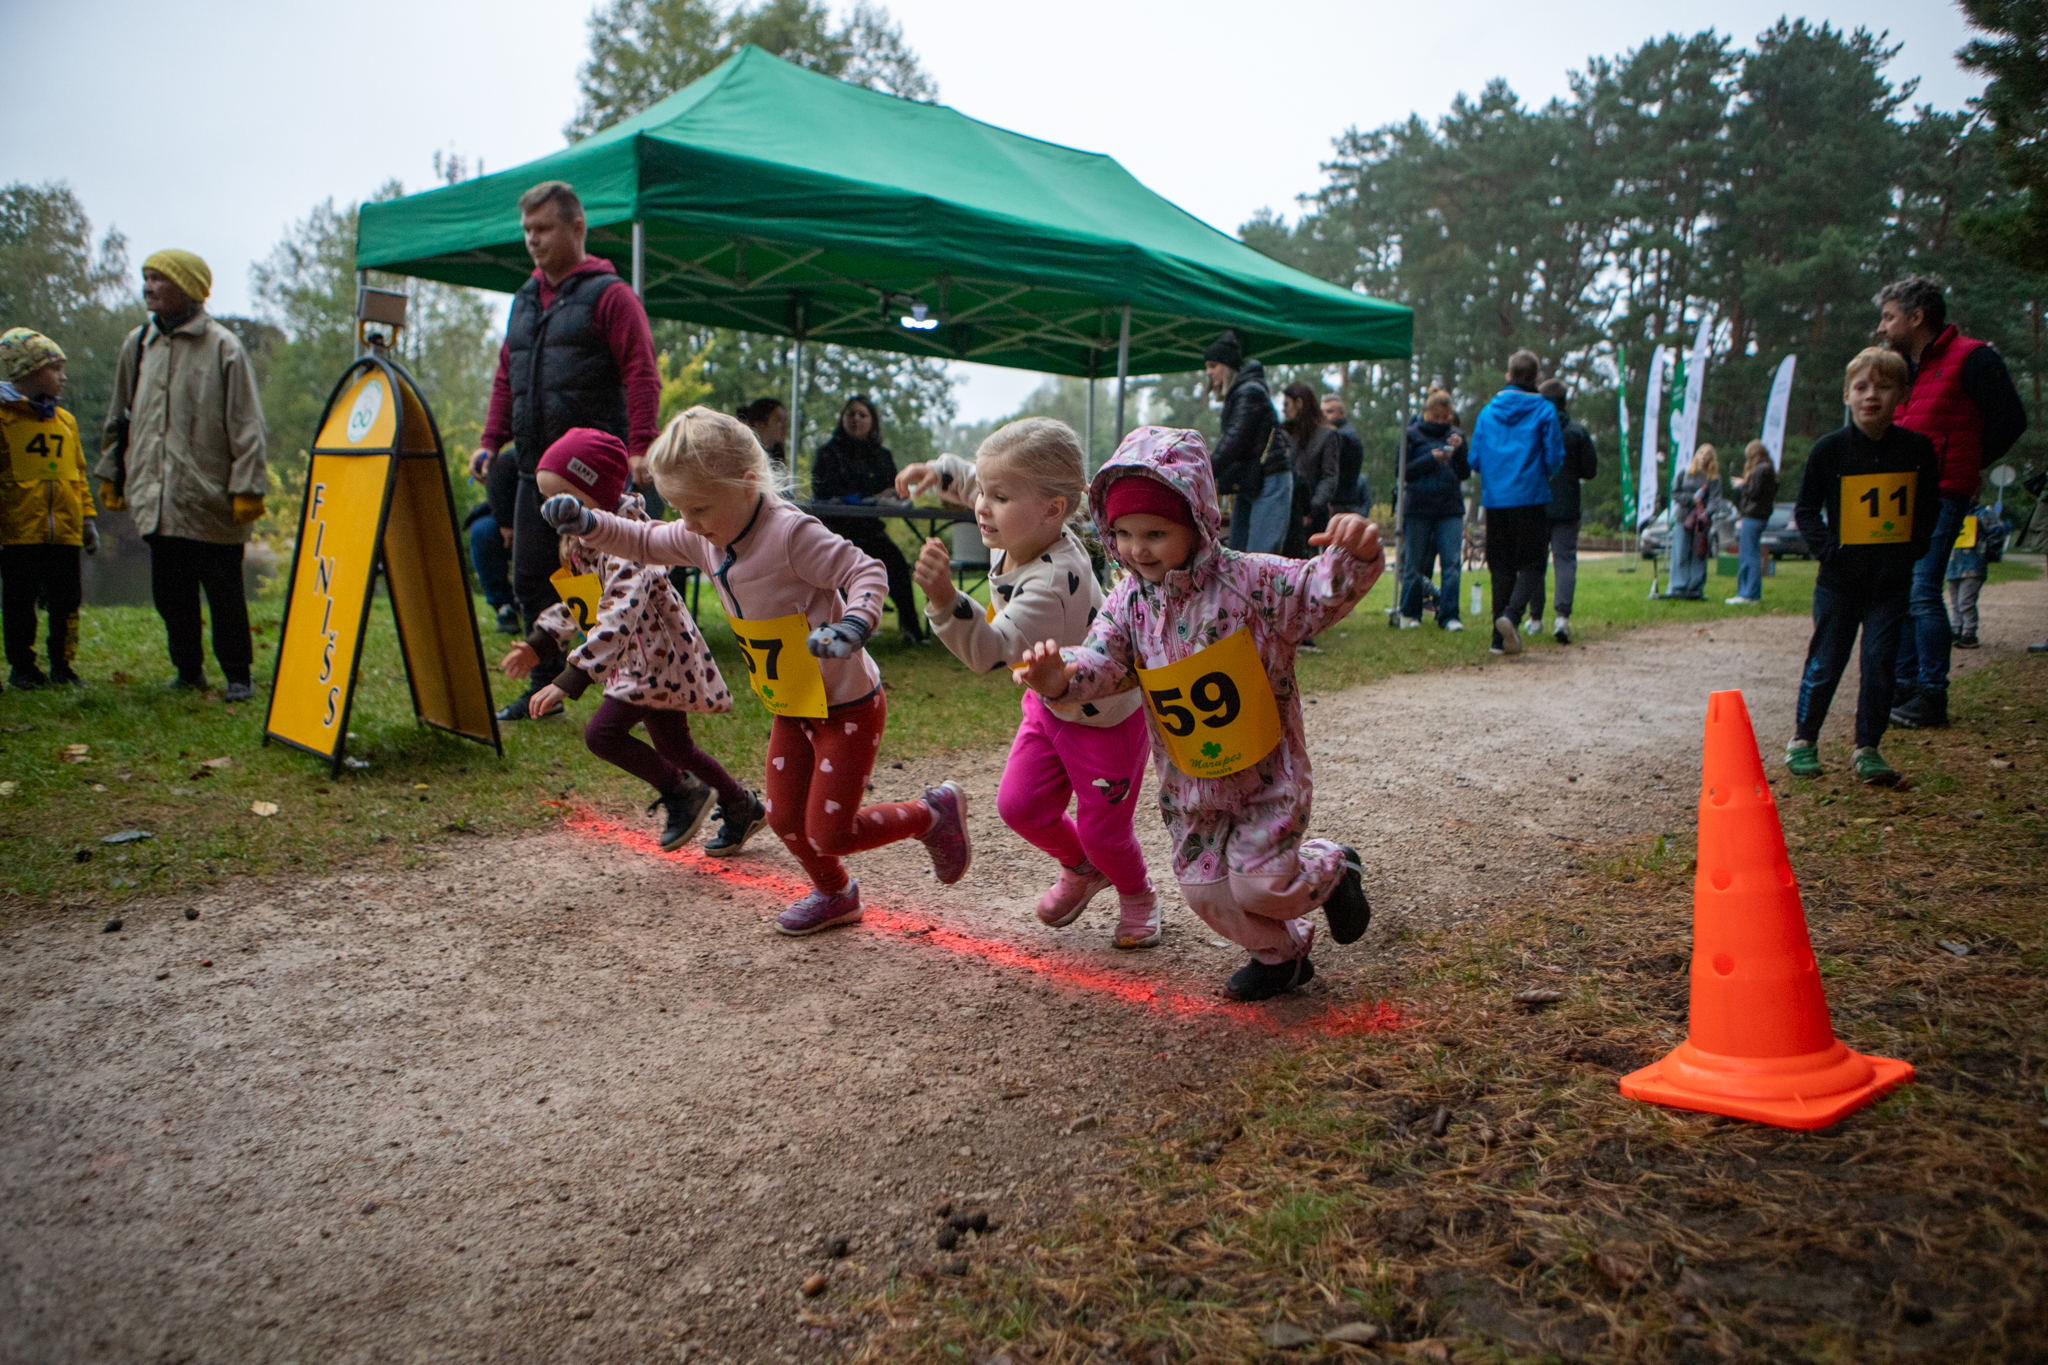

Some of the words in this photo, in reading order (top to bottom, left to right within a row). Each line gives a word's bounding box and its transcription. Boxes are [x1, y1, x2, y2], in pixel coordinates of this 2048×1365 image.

[26, 433, 64, 458] 47
[570, 460, 597, 482] HAPPY
[1860, 486, 1907, 518] 11
[310, 483, 340, 728] FINIŠS
[1149, 671, 1241, 737] 59
